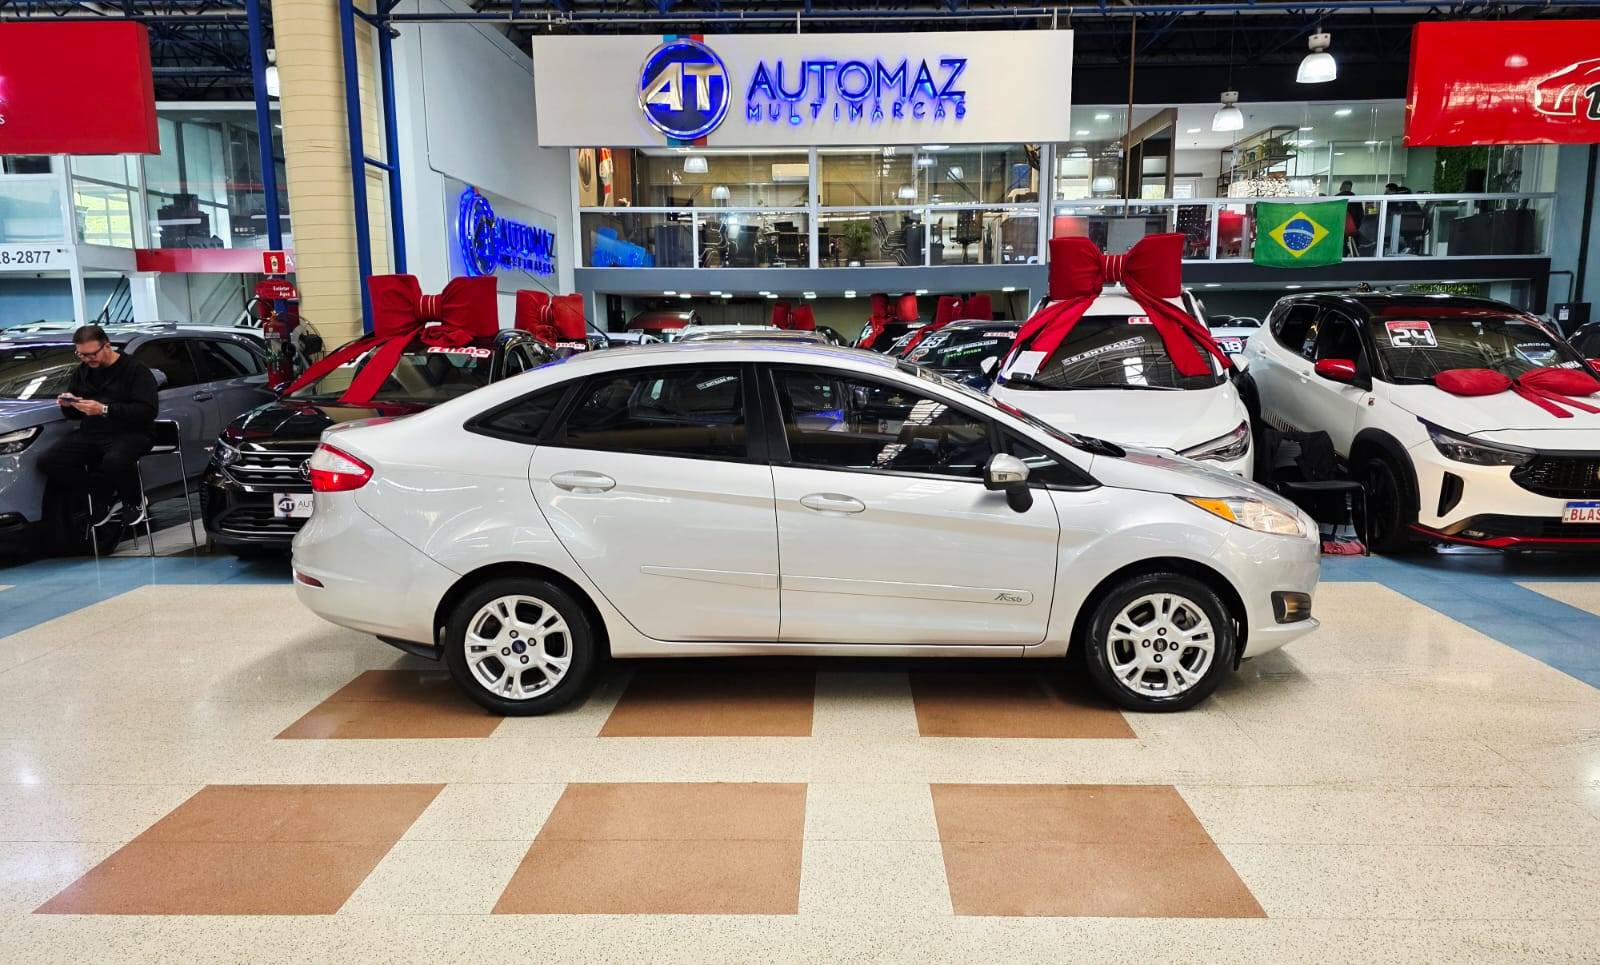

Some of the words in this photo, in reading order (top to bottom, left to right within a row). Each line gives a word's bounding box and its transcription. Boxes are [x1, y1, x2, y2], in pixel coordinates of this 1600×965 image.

[748, 57, 968, 101] AUTOMAZ
[748, 101, 967, 123] MULTIMARCAS
[0, 250, 51, 264] 8-2877
[1082, 337, 1136, 359] ENTRADA
[1391, 328, 1435, 346] 24
